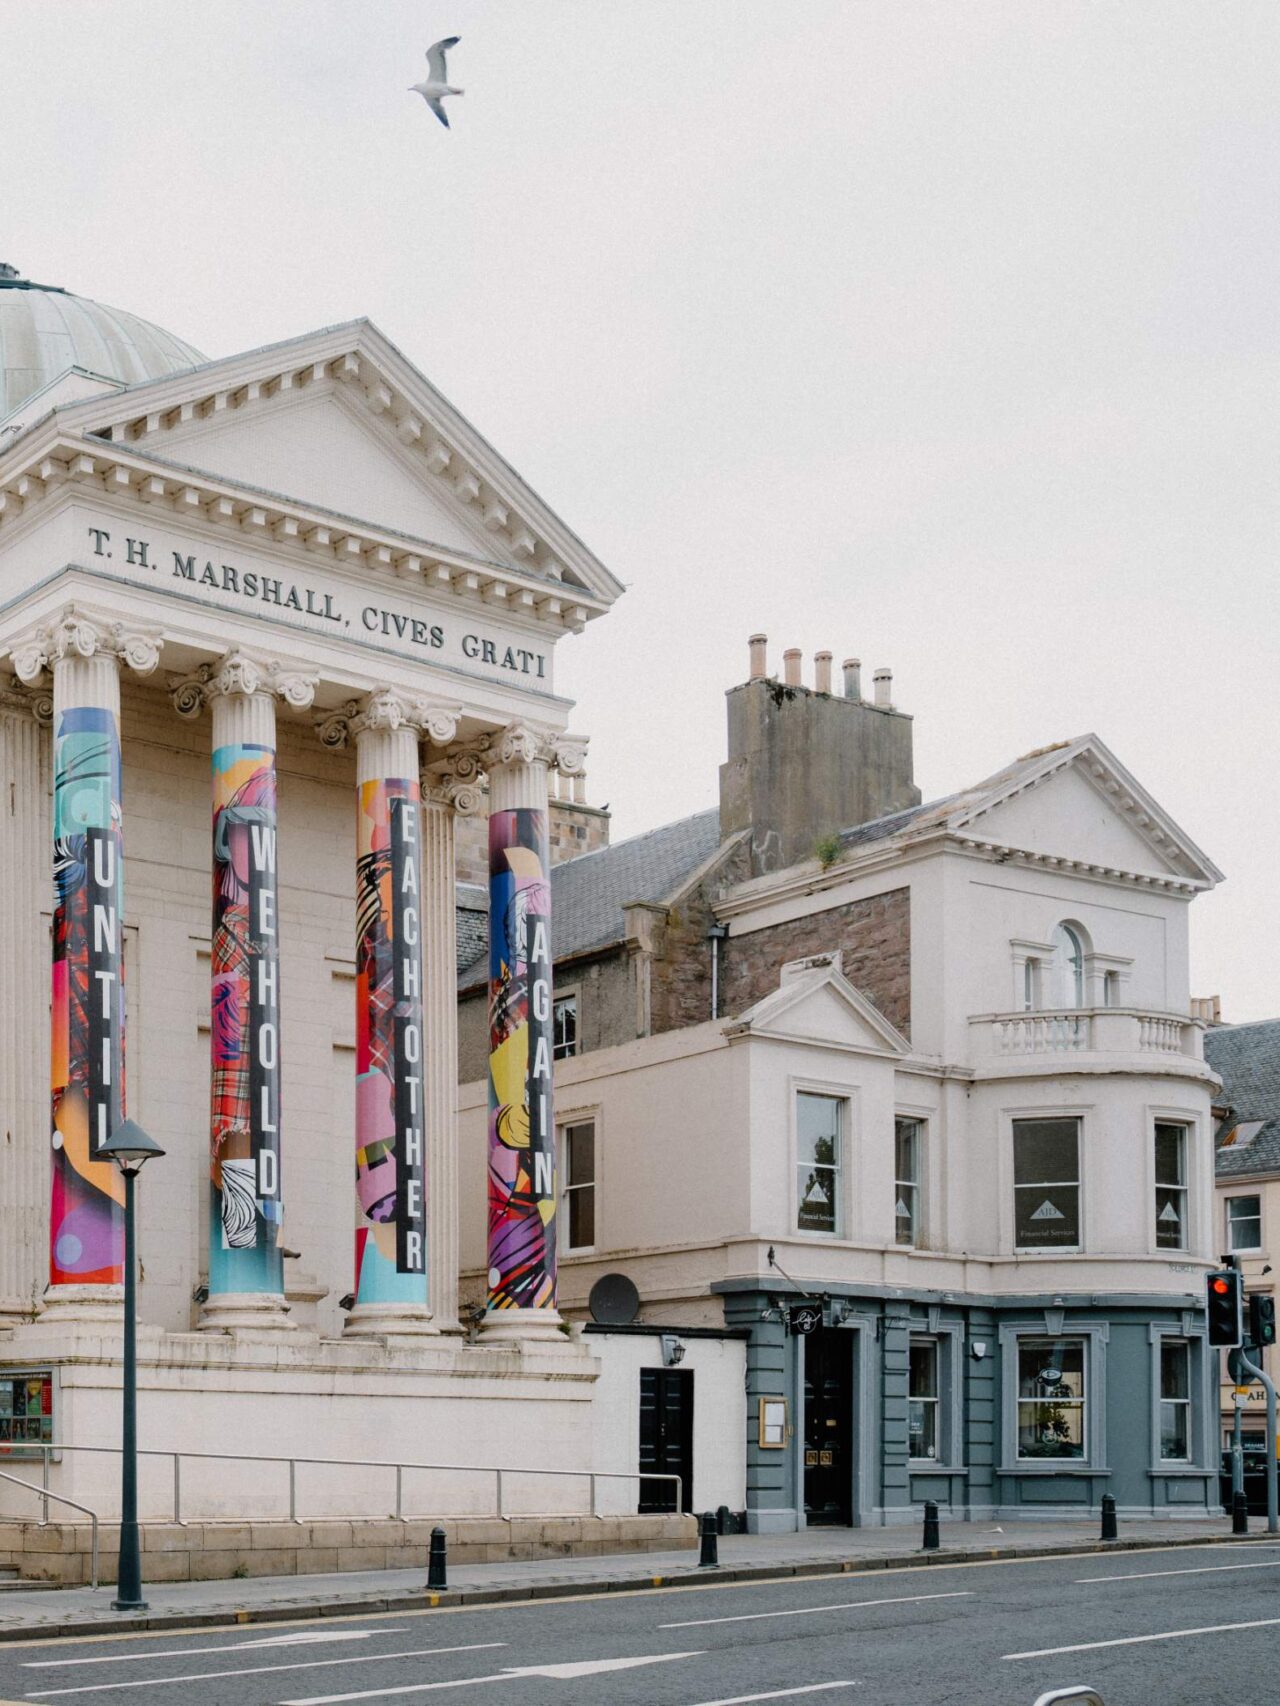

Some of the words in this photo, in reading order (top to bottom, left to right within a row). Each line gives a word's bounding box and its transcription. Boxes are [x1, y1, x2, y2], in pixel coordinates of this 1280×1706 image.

[88, 527, 113, 558] T.
[125, 538, 157, 570] H.
[172, 551, 351, 628] MARSHALL,
[361, 606, 445, 649] CIVES
[461, 634, 545, 678] GRATI
[530, 919, 553, 1196] AGAIN
[1020, 1230, 1049, 1238] Financial
[1037, 1207, 1057, 1216] AJD
